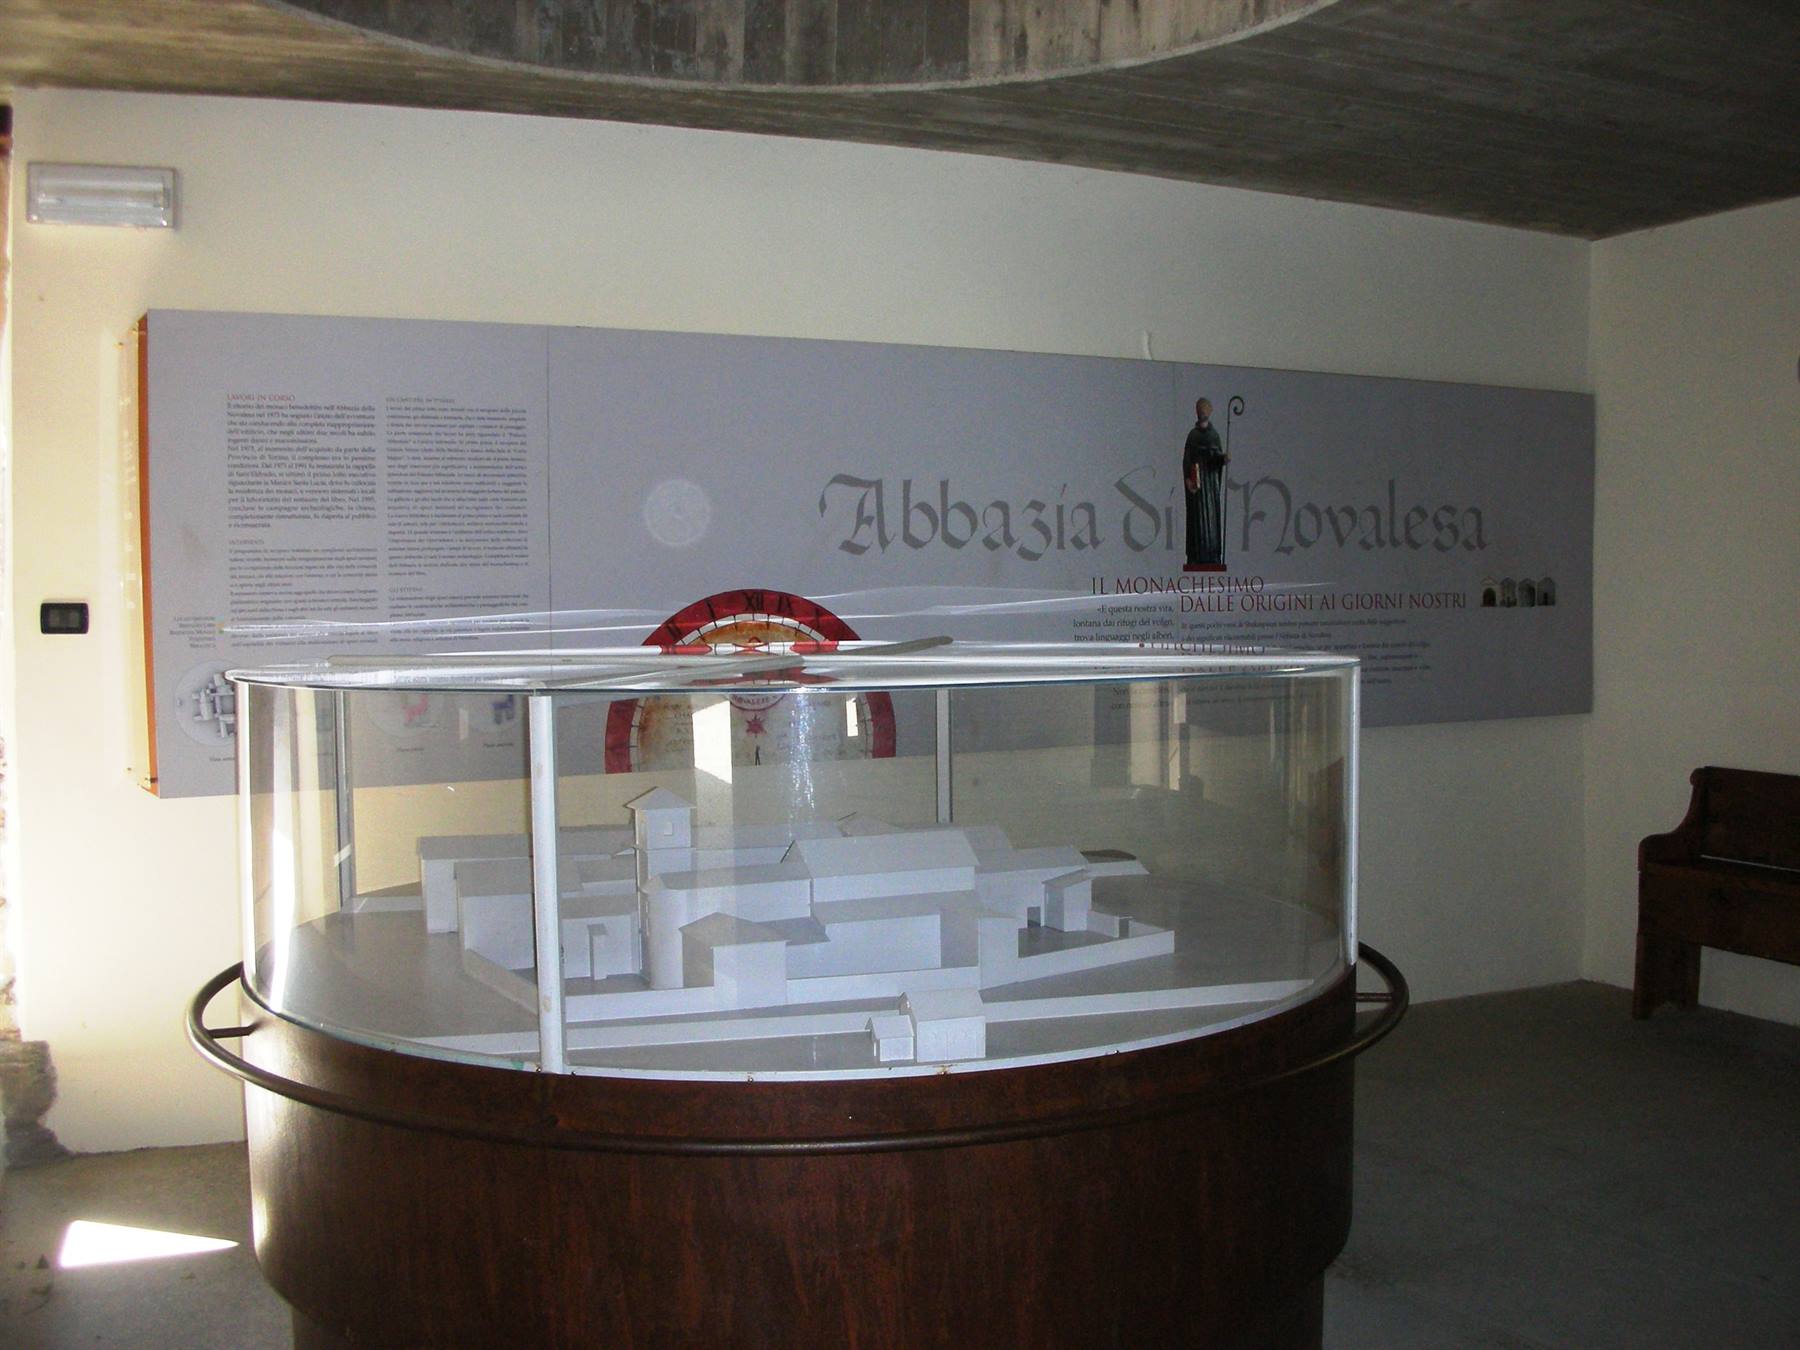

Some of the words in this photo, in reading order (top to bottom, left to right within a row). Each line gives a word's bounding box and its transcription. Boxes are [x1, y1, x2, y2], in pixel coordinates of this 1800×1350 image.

[819, 474, 1105, 562] Abbazia
[1114, 465, 1176, 552] di
[1227, 476, 1488, 556] Novalesa
[1091, 577, 1109, 595] IL
[1115, 576, 1265, 595] MONACHESIMO
[1180, 595, 1234, 613] DALLE
[1240, 593, 1314, 612] ORIGINI
[1319, 593, 1336, 611] AI
[1341, 592, 1402, 611] GIORNI
[1408, 591, 1467, 610] NOSTRI
[1108, 604, 1132, 616] questa
[1072, 619, 1101, 628] lontana
[1102, 619, 1116, 627] dai
[1138, 618, 1151, 626] del
[1074, 633, 1094, 641] trova
[1096, 632, 1130, 643] linguaggi
[1132, 632, 1150, 642] negli
